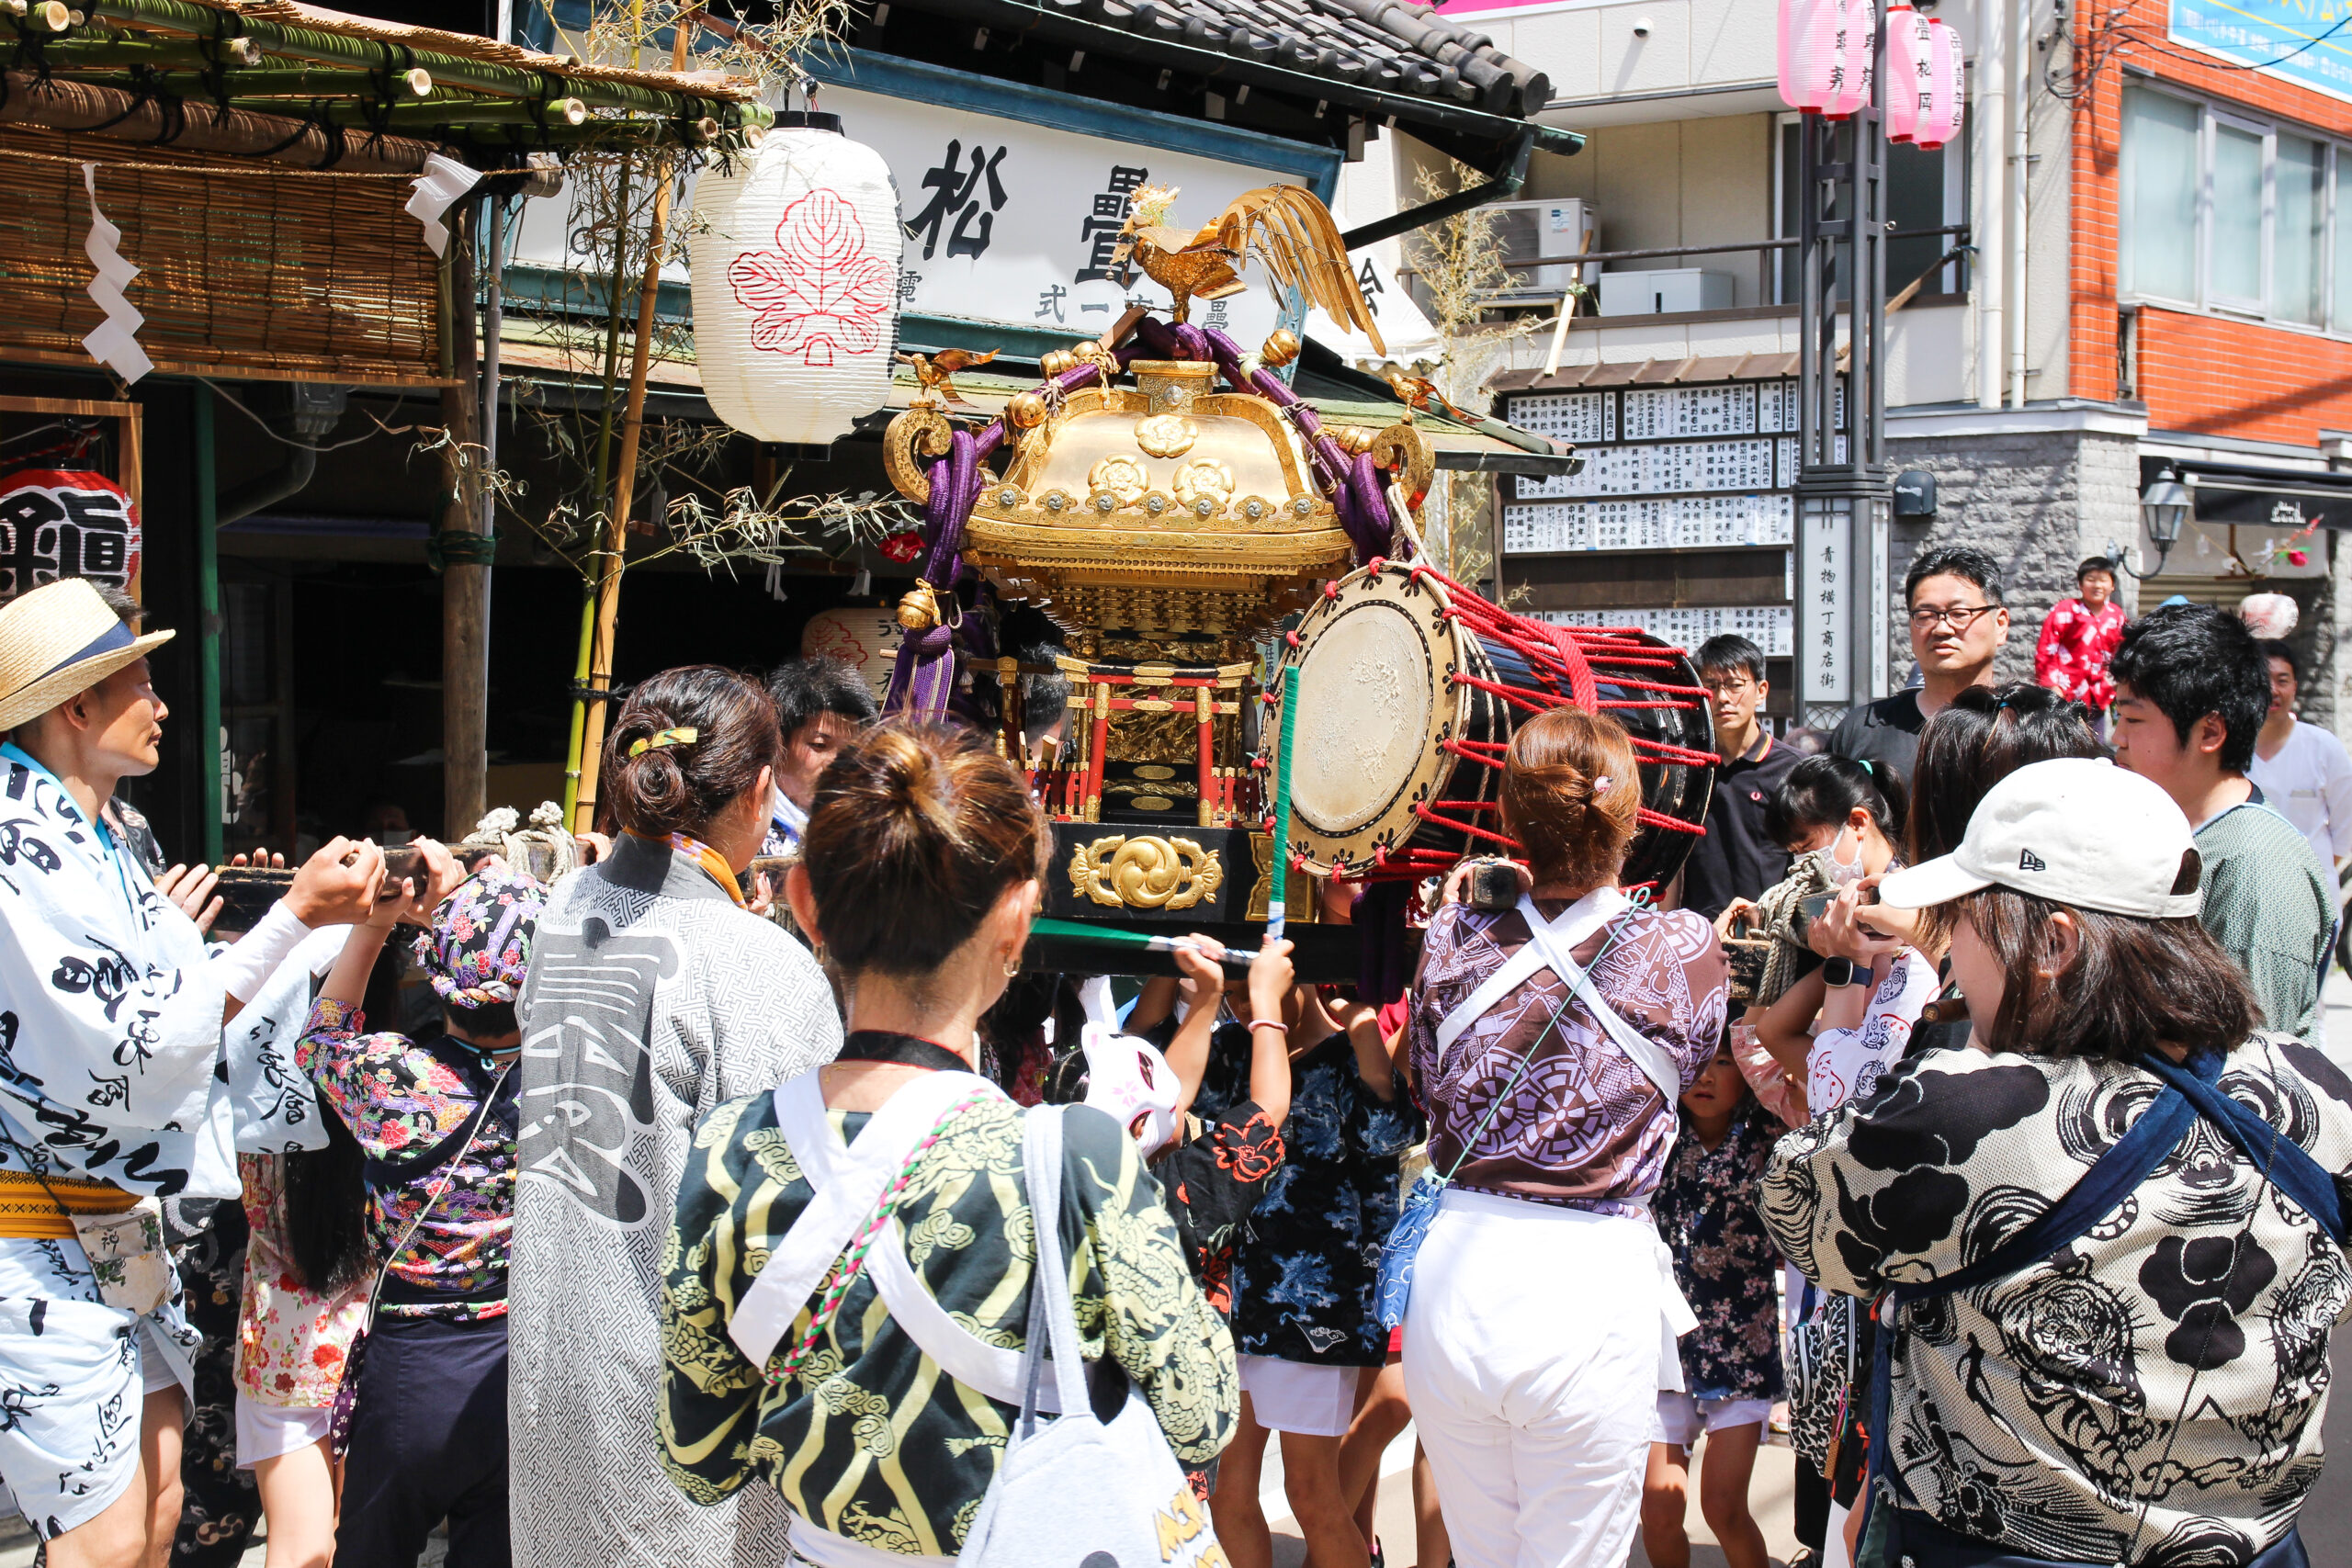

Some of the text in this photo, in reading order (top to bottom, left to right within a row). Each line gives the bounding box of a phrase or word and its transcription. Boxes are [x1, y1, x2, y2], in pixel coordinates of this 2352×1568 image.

[905, 138, 1009, 261] 松
[1626, 393, 1634, 436] 天妙国寺
[1820, 546, 1837, 690] 青物横丁商店街
